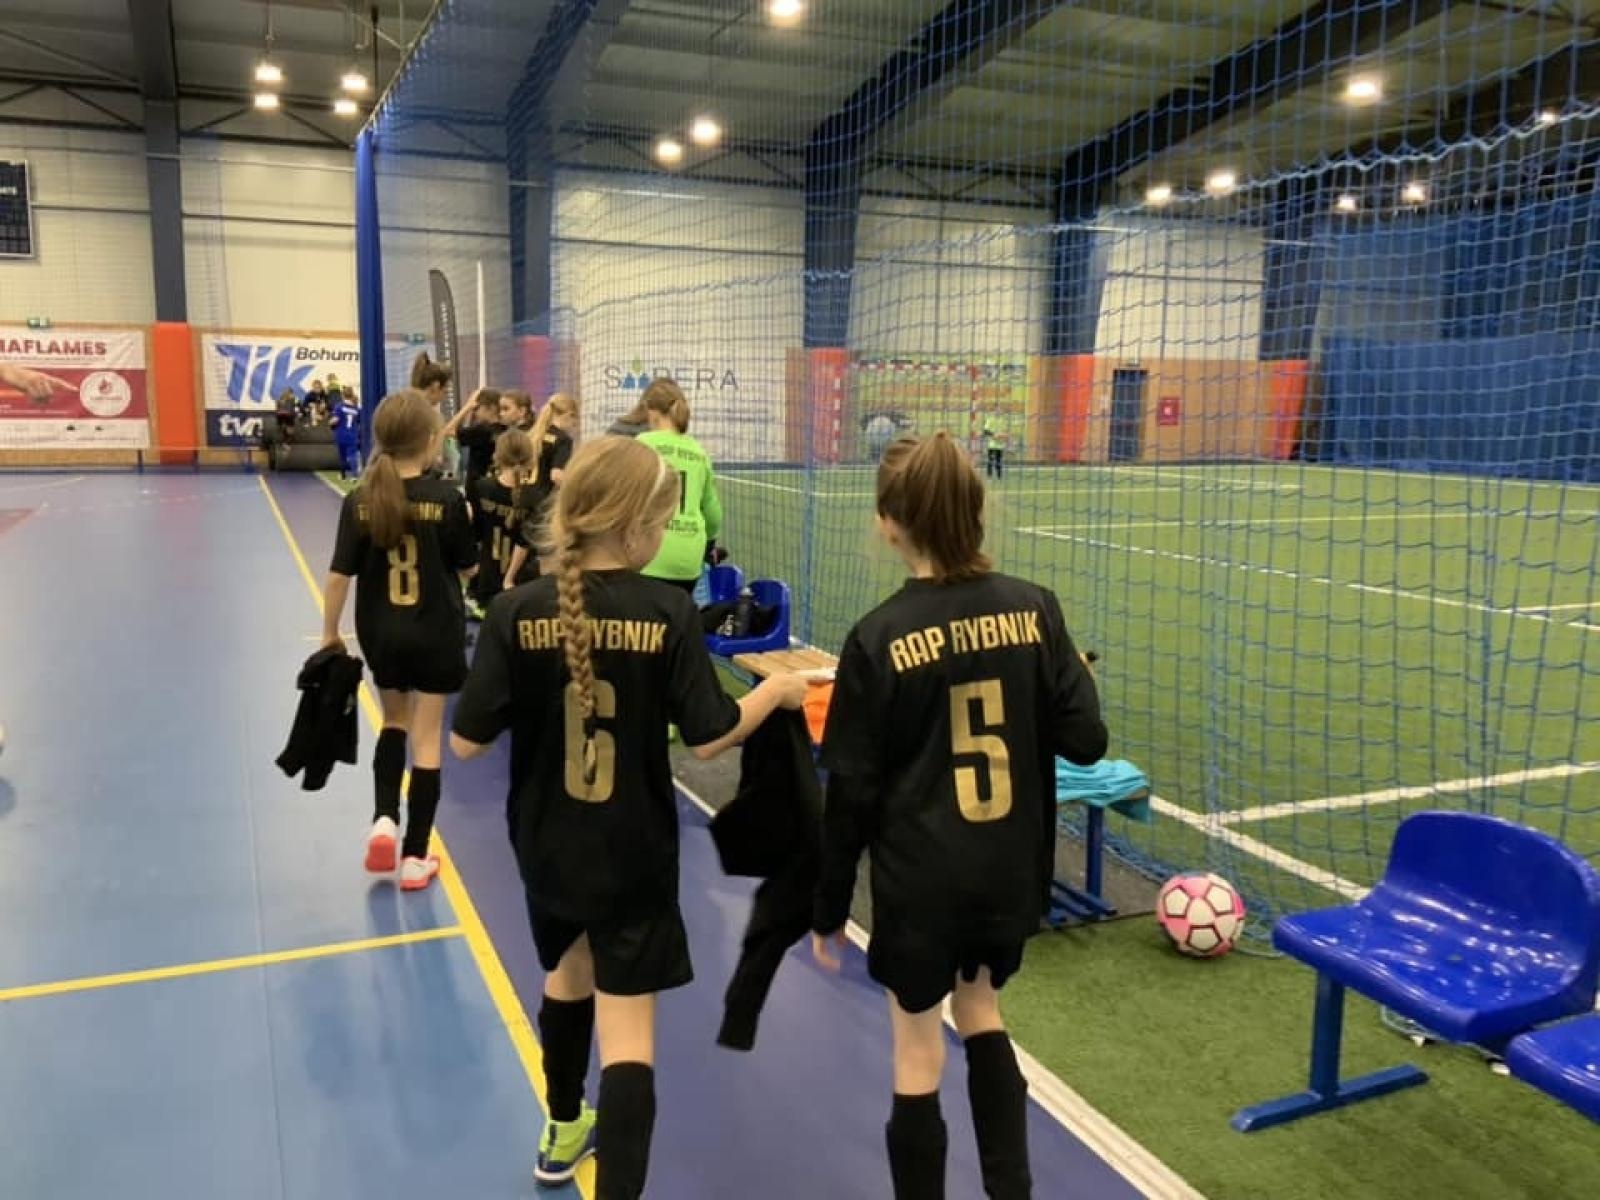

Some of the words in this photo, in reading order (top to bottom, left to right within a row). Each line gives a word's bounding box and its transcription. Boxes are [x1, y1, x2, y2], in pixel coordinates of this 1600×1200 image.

[387, 534, 421, 606] 8
[890, 627, 947, 672] RAP
[951, 610, 1042, 654] RYBNIK
[564, 679, 617, 804] 6
[949, 679, 1013, 823] 5
